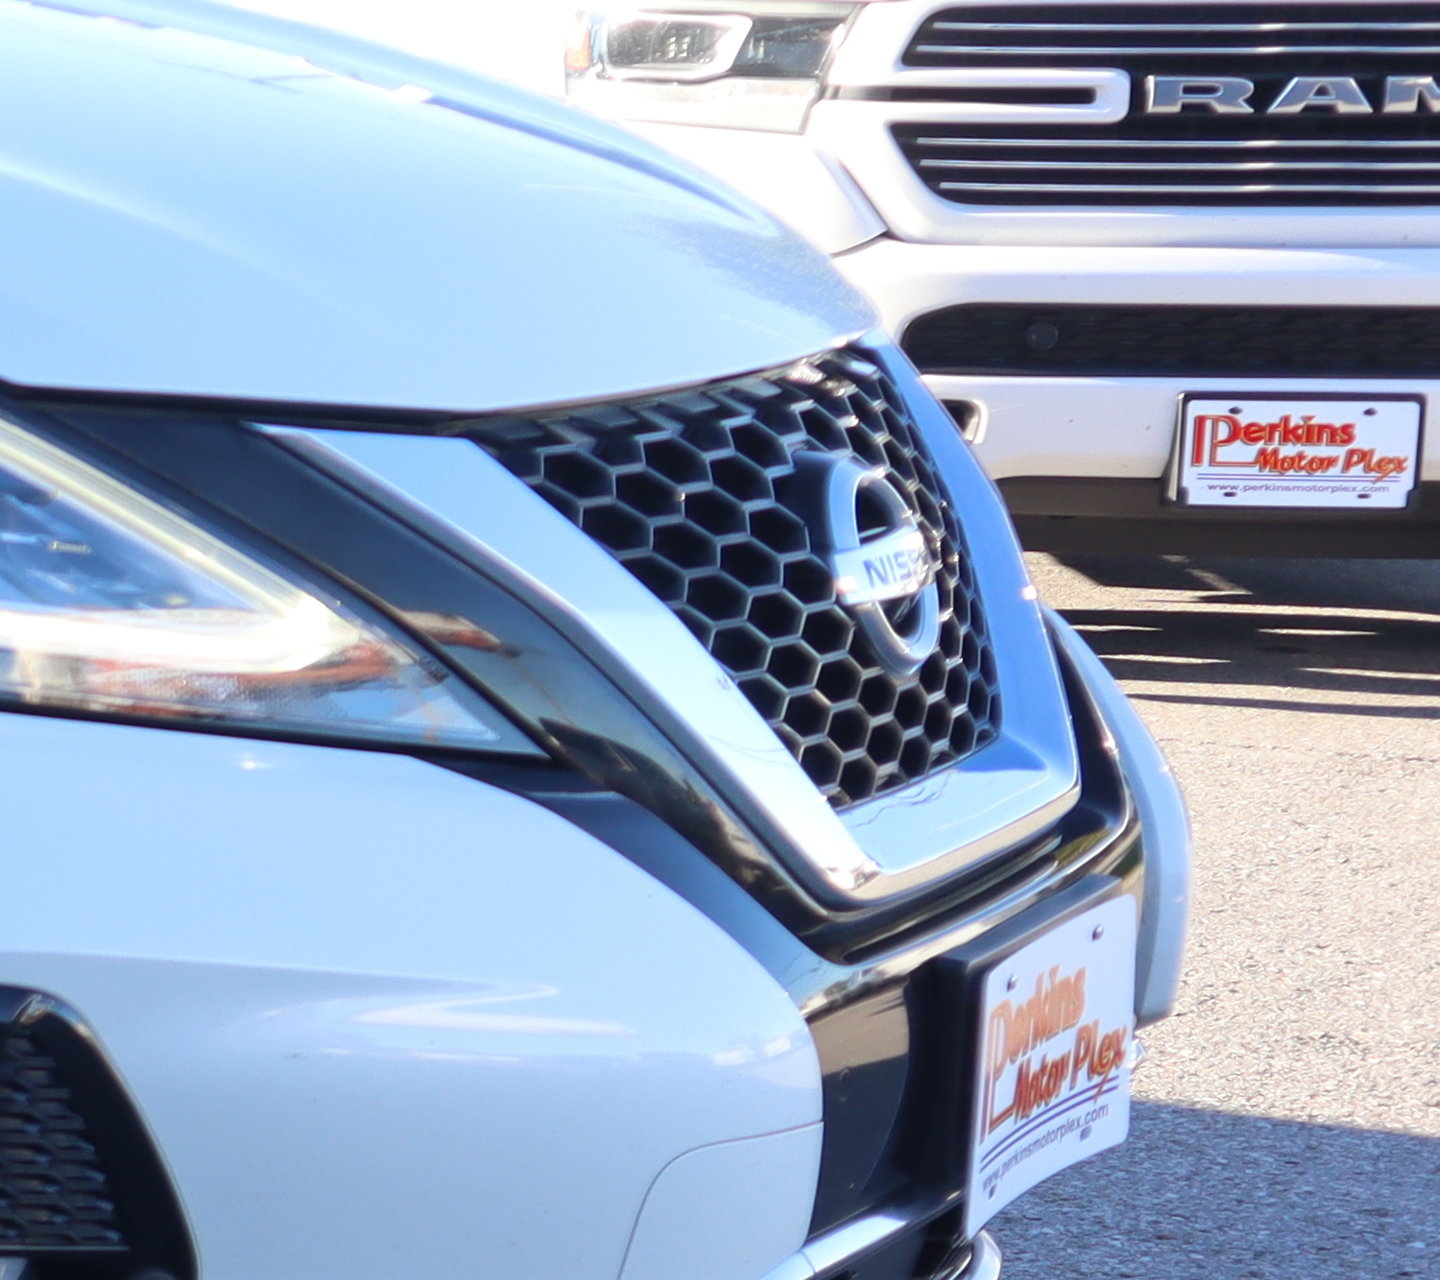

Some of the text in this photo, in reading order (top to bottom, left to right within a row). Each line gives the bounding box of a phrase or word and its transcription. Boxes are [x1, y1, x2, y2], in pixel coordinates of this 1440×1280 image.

[1191, 414, 1356, 467] Perkins
[1256, 447, 1409, 484] Motor Plex
[1207, 483, 1389, 493] www.perkinsmotorplex.com
[979, 964, 1086, 1145] Perkins
[1015, 1018, 1128, 1124] Motor Plex
[983, 1104, 1110, 1191] www.perkinsmotorplex.com
